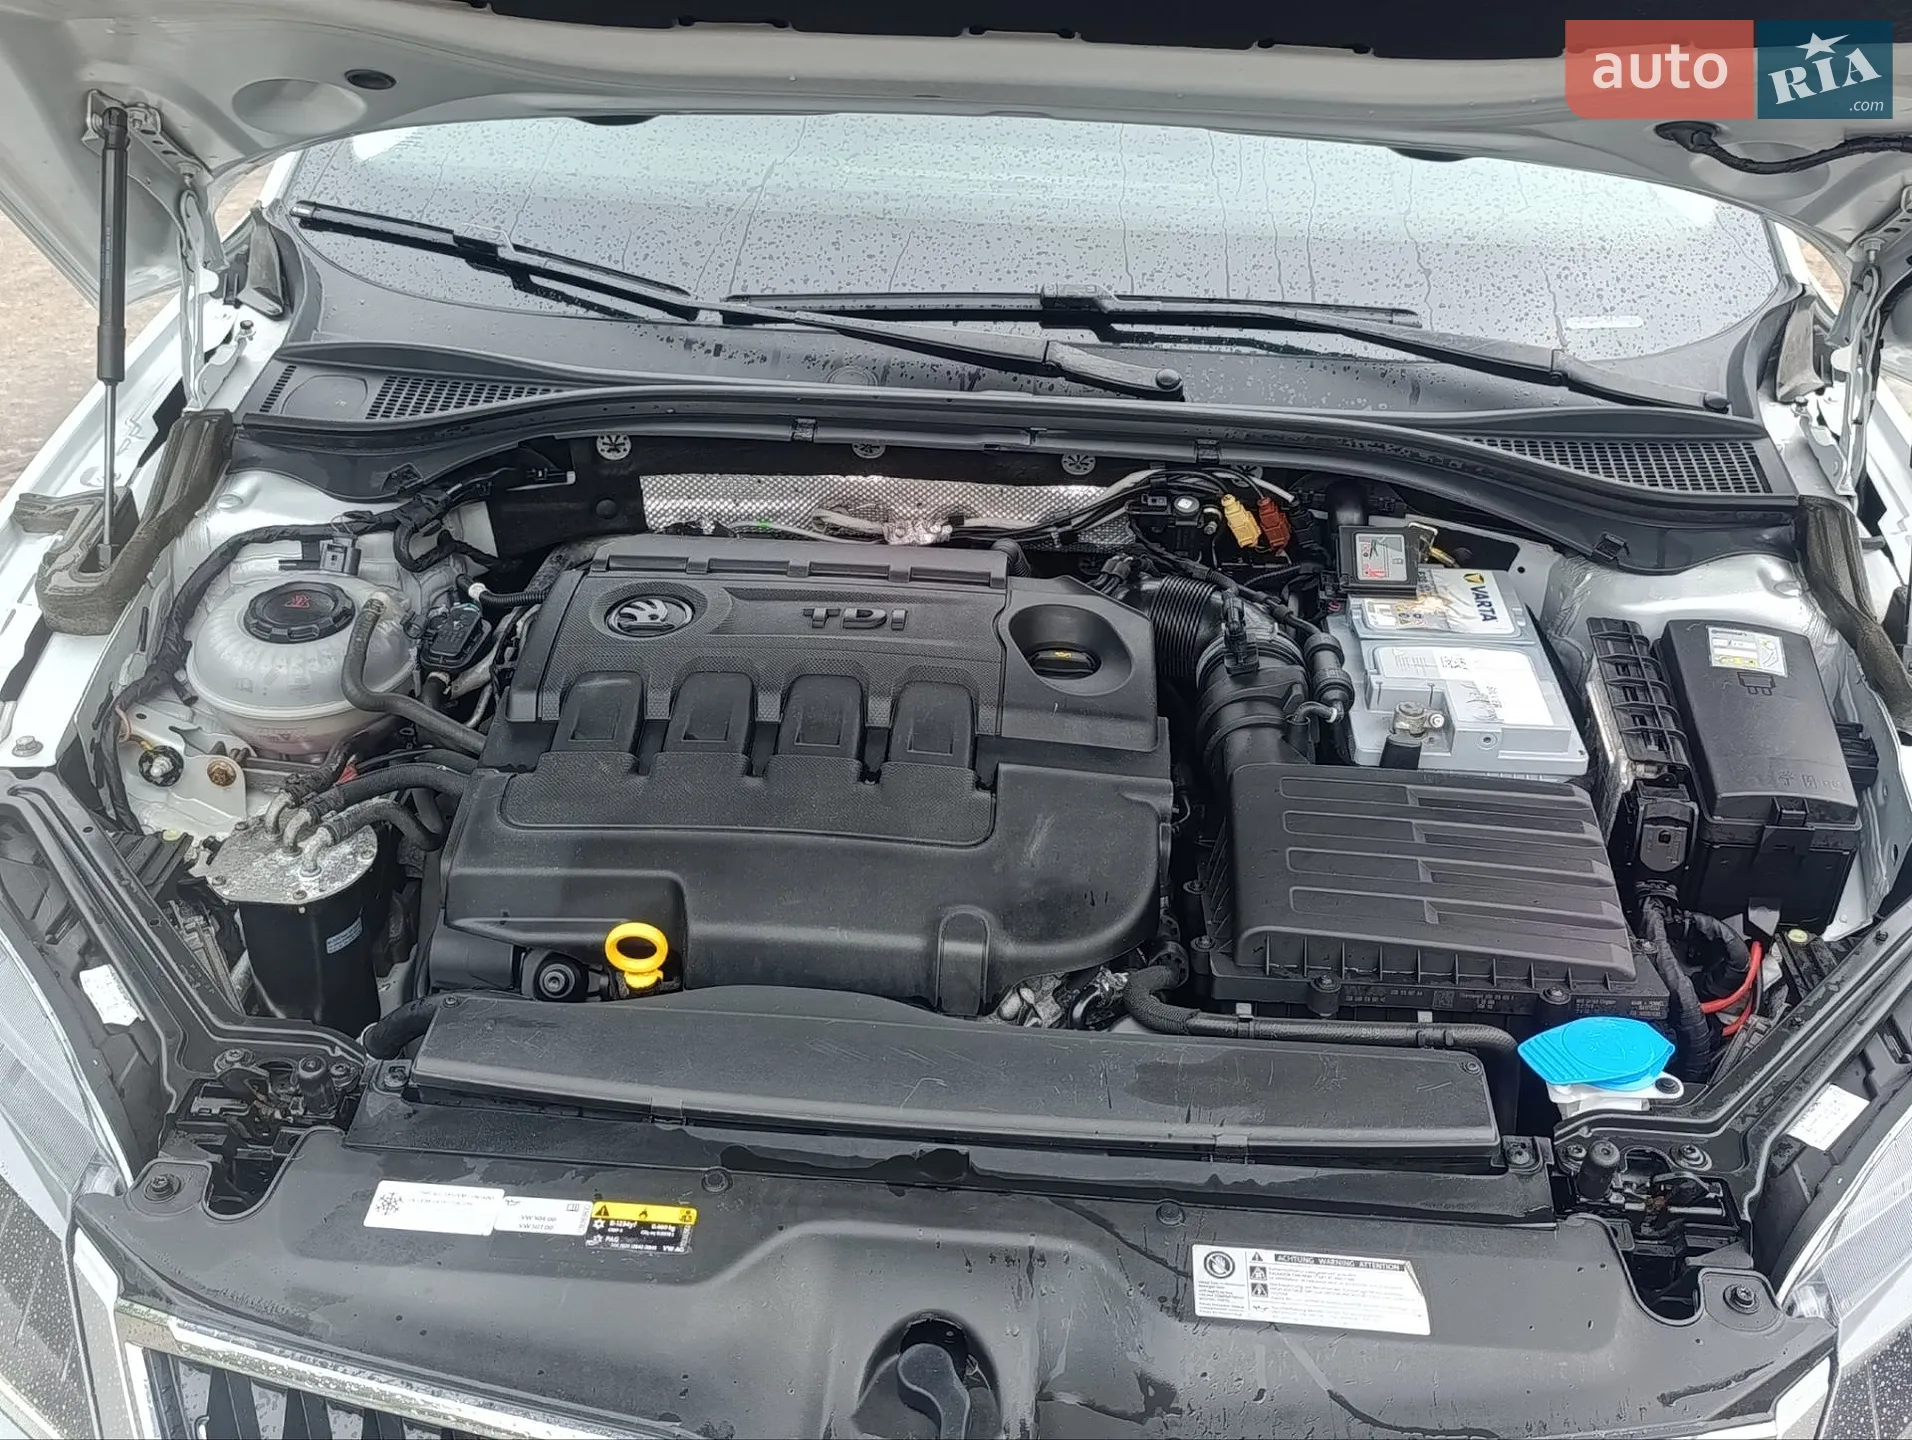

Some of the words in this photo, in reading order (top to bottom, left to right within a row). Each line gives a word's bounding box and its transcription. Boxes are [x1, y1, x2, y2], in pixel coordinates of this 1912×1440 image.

[1470, 585, 1498, 622] VARTA
[803, 607, 908, 631] TDI
[1277, 1254, 1315, 1264] ACHTUNG
[1319, 1258, 1355, 1267] WARNING
[1359, 1261, 1400, 1270] ATTENTION
